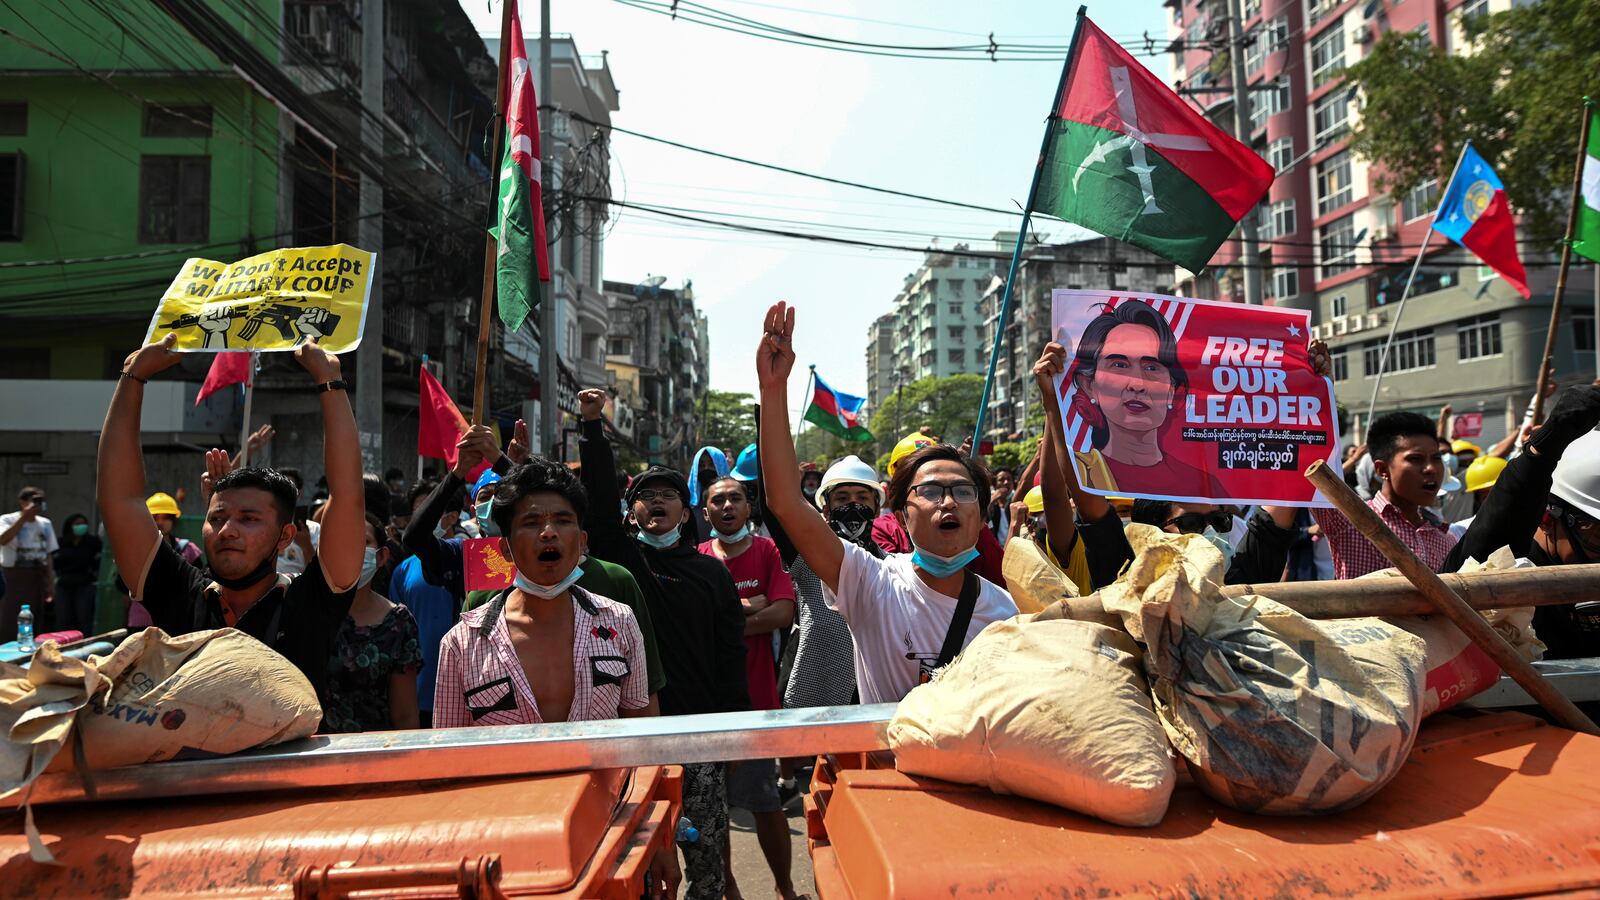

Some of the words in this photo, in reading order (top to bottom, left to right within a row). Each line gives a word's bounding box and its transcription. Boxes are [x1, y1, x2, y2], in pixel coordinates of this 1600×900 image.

[192, 265, 227, 282] We
[230, 257, 288, 279] Don't
[290, 256, 363, 276] Accept
[185, 275, 288, 298] MILITARY
[292, 275, 355, 293] COUP
[1201, 336, 1284, 368] FREE
[1212, 367, 1288, 394] OUR
[1185, 394, 1322, 426] LEADER
[1222, 442, 1294, 470] ချက်ချင်းလွှတ်
[1440, 679, 1466, 702] SCG
